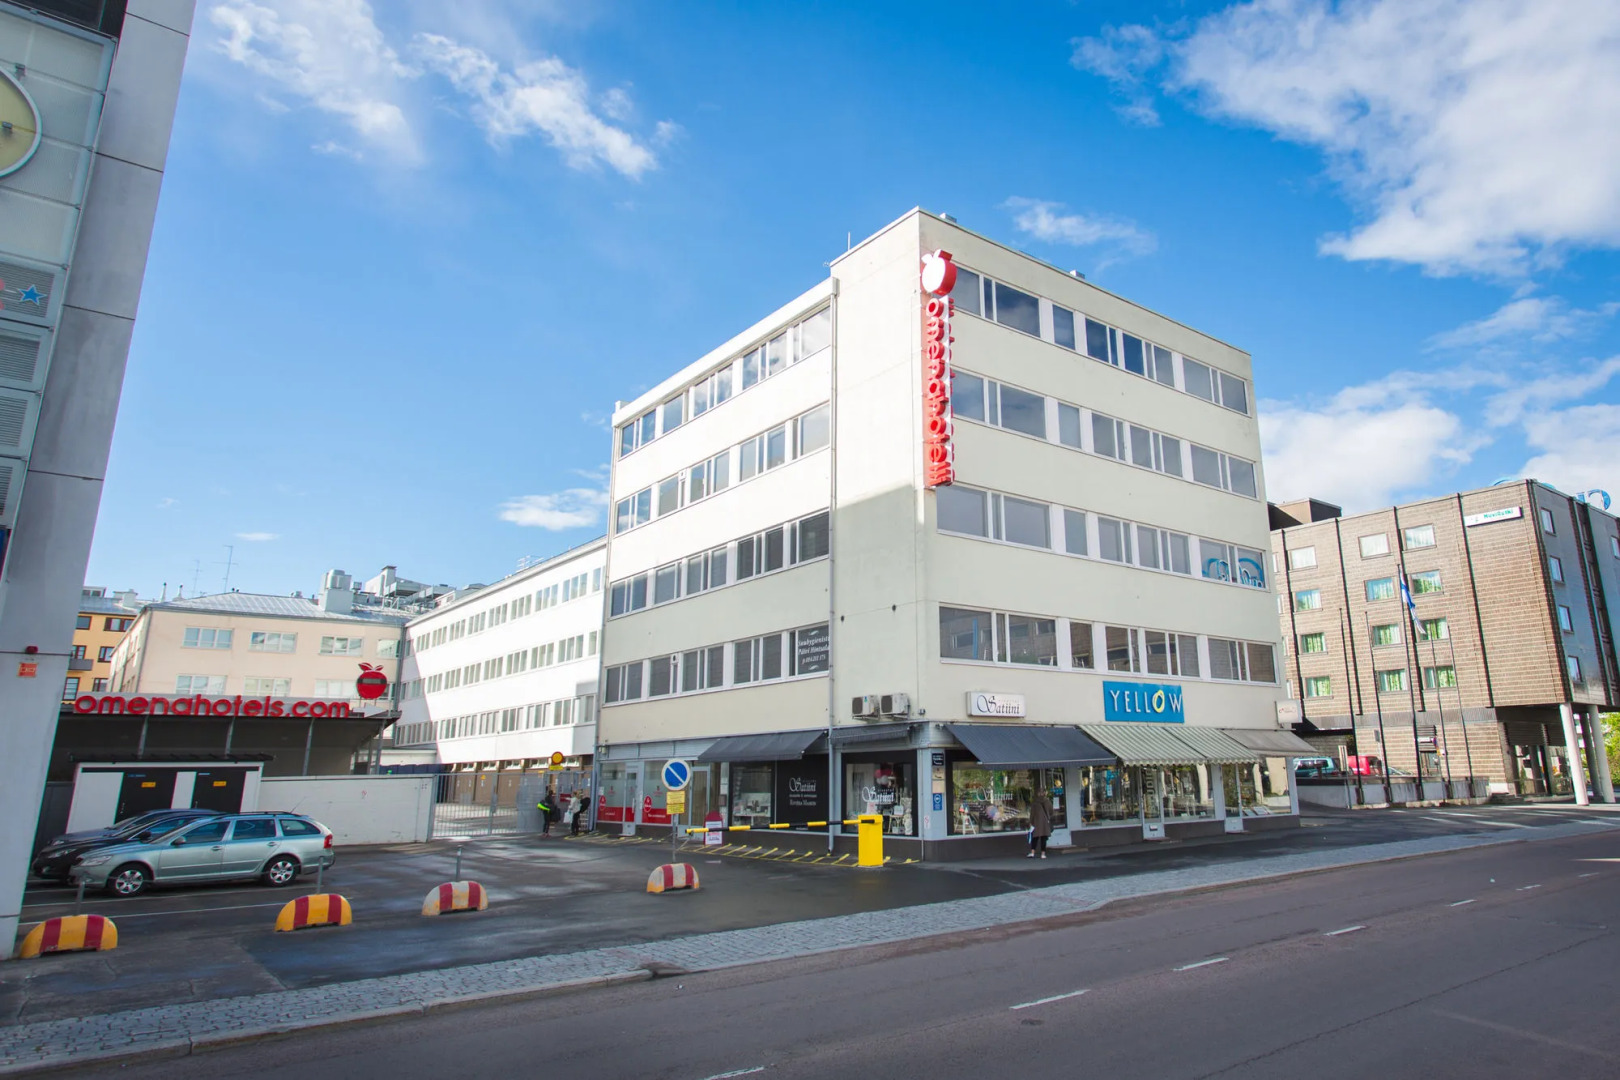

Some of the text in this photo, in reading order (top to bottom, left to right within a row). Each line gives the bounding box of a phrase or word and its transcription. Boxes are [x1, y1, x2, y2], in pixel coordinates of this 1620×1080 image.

[74, 694, 350, 718] omenahotels.com
[976, 694, 1020, 714] Satiini
[1110, 689, 1182, 713] YELLOW
[789, 777, 816, 792] Satiini
[861, 786, 894, 802] Satiini
